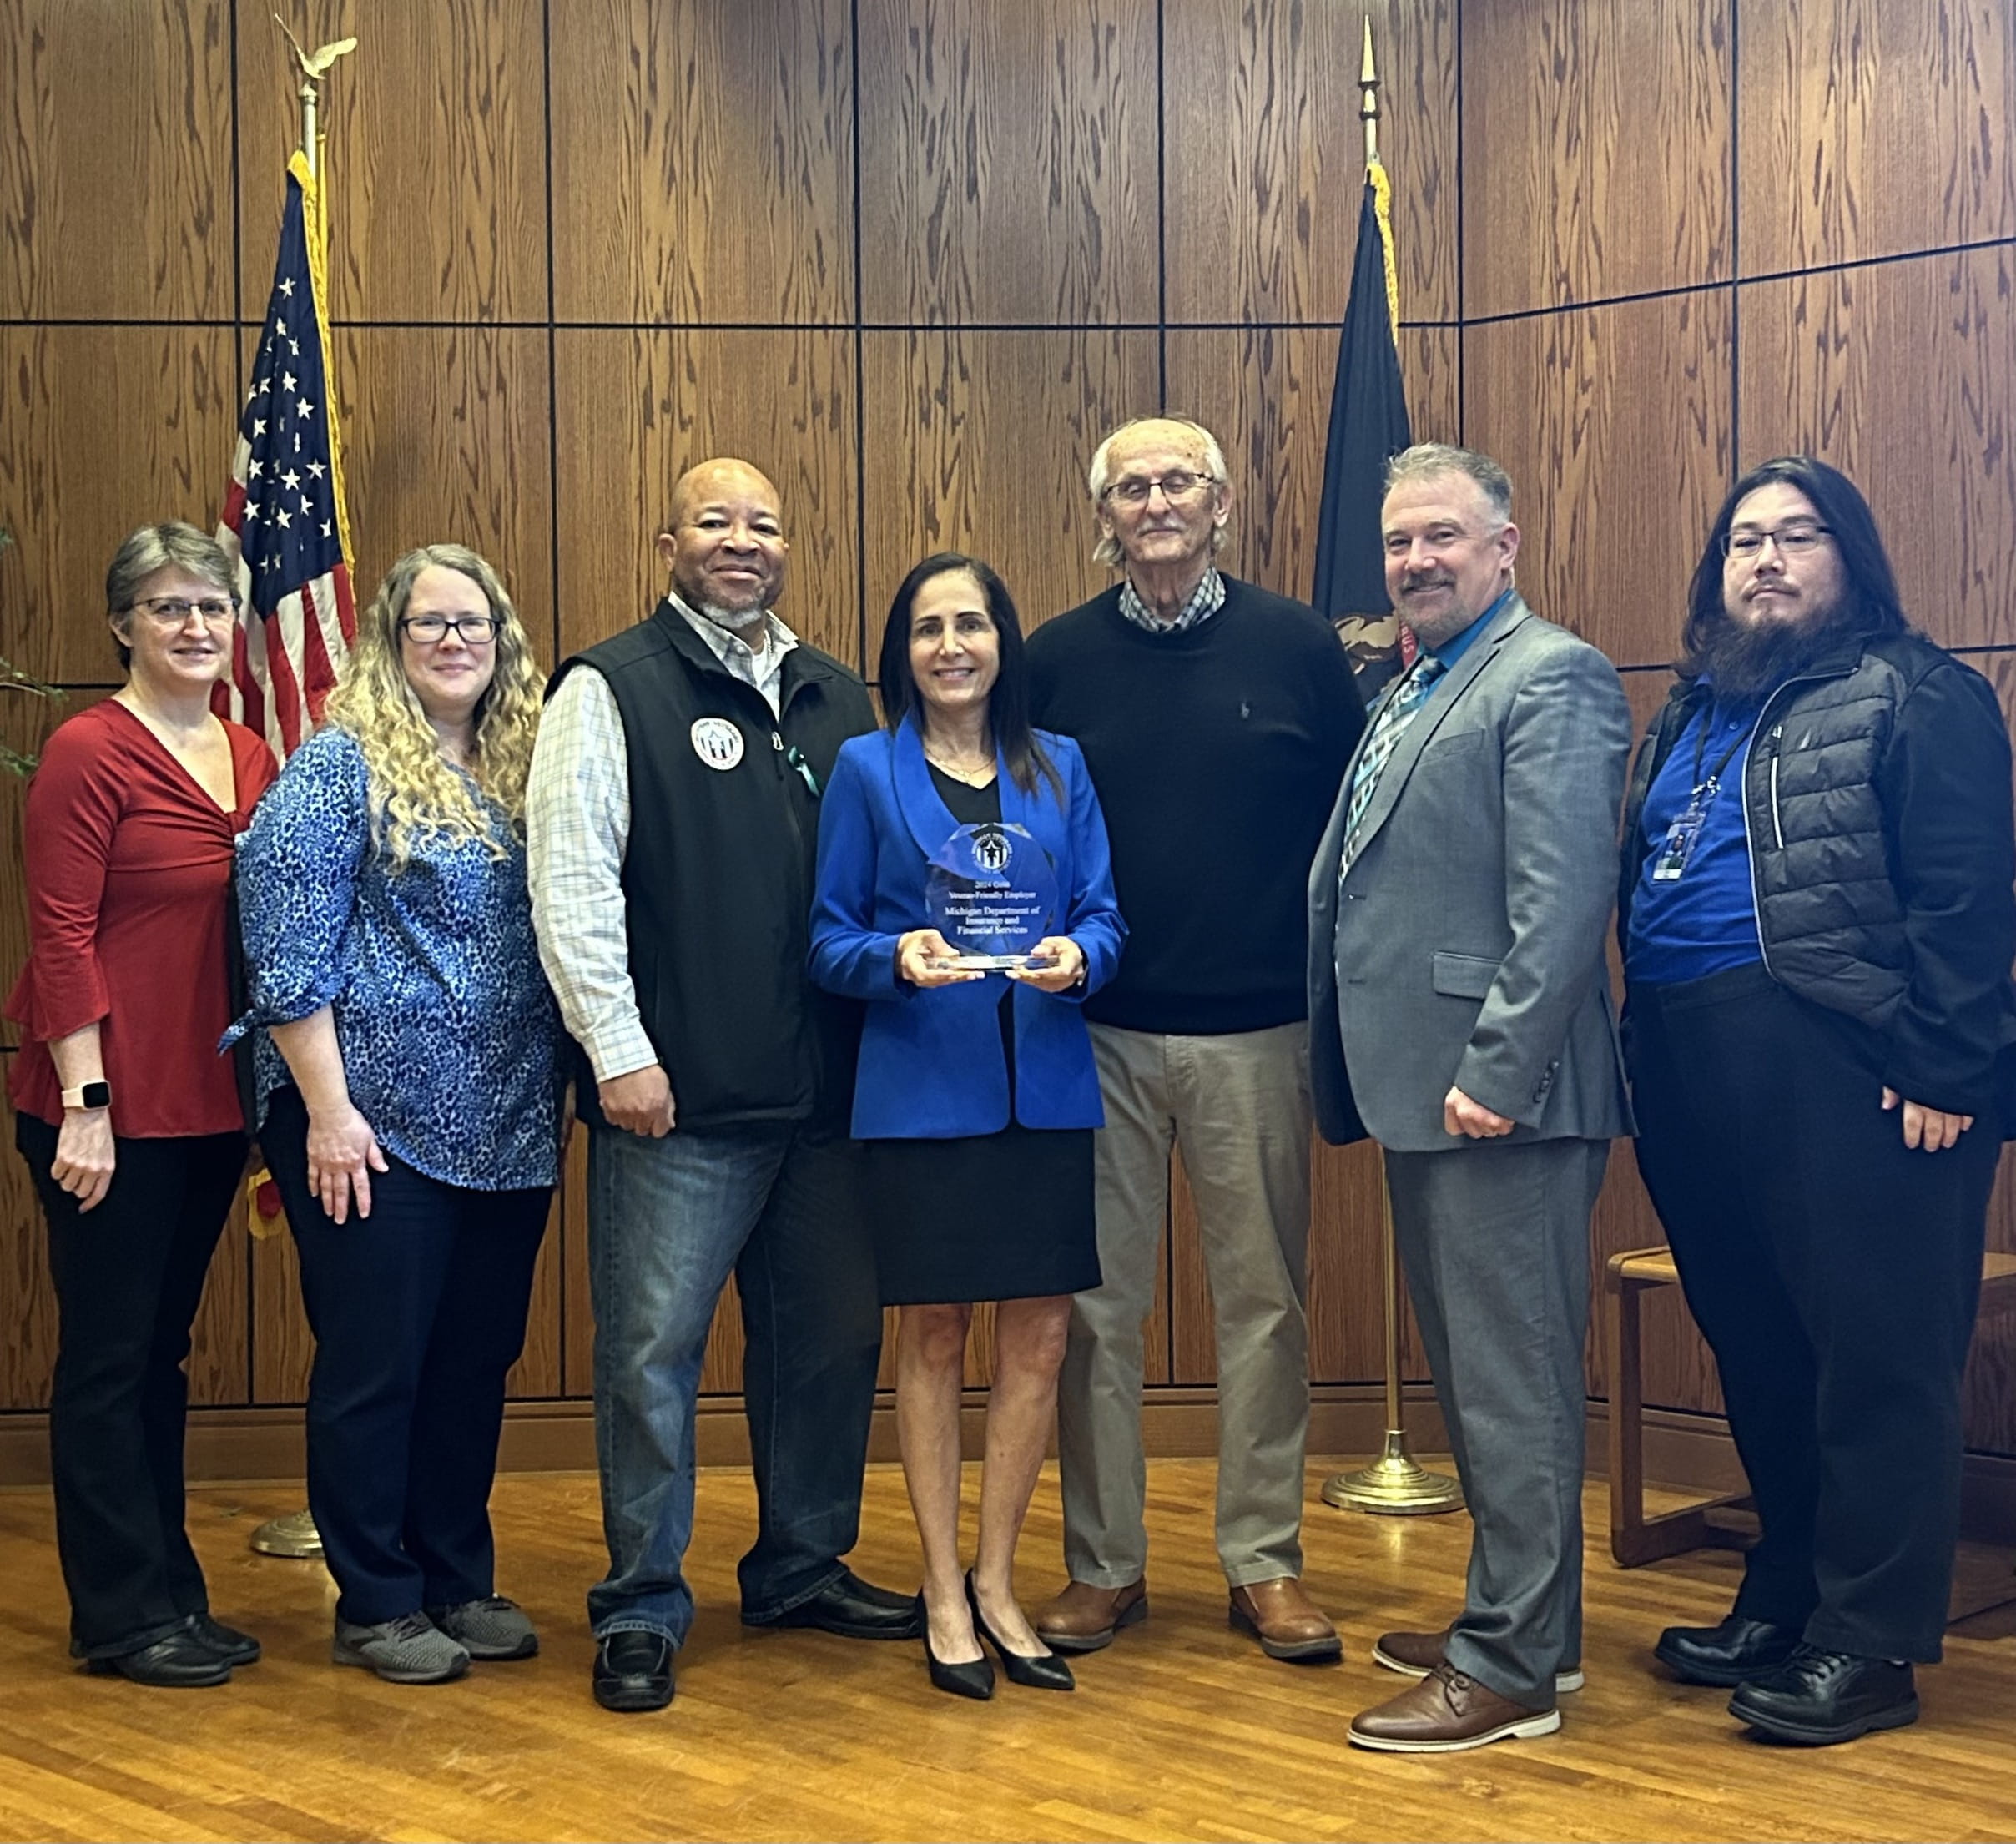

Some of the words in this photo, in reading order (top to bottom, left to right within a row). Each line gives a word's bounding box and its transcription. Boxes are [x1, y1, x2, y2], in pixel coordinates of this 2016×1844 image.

[945, 907, 982, 916] Michigan
[984, 906, 1029, 916] Department
[1031, 906, 1041, 914] of
[957, 926, 993, 935] Financial
[995, 926, 1028, 935] Services
